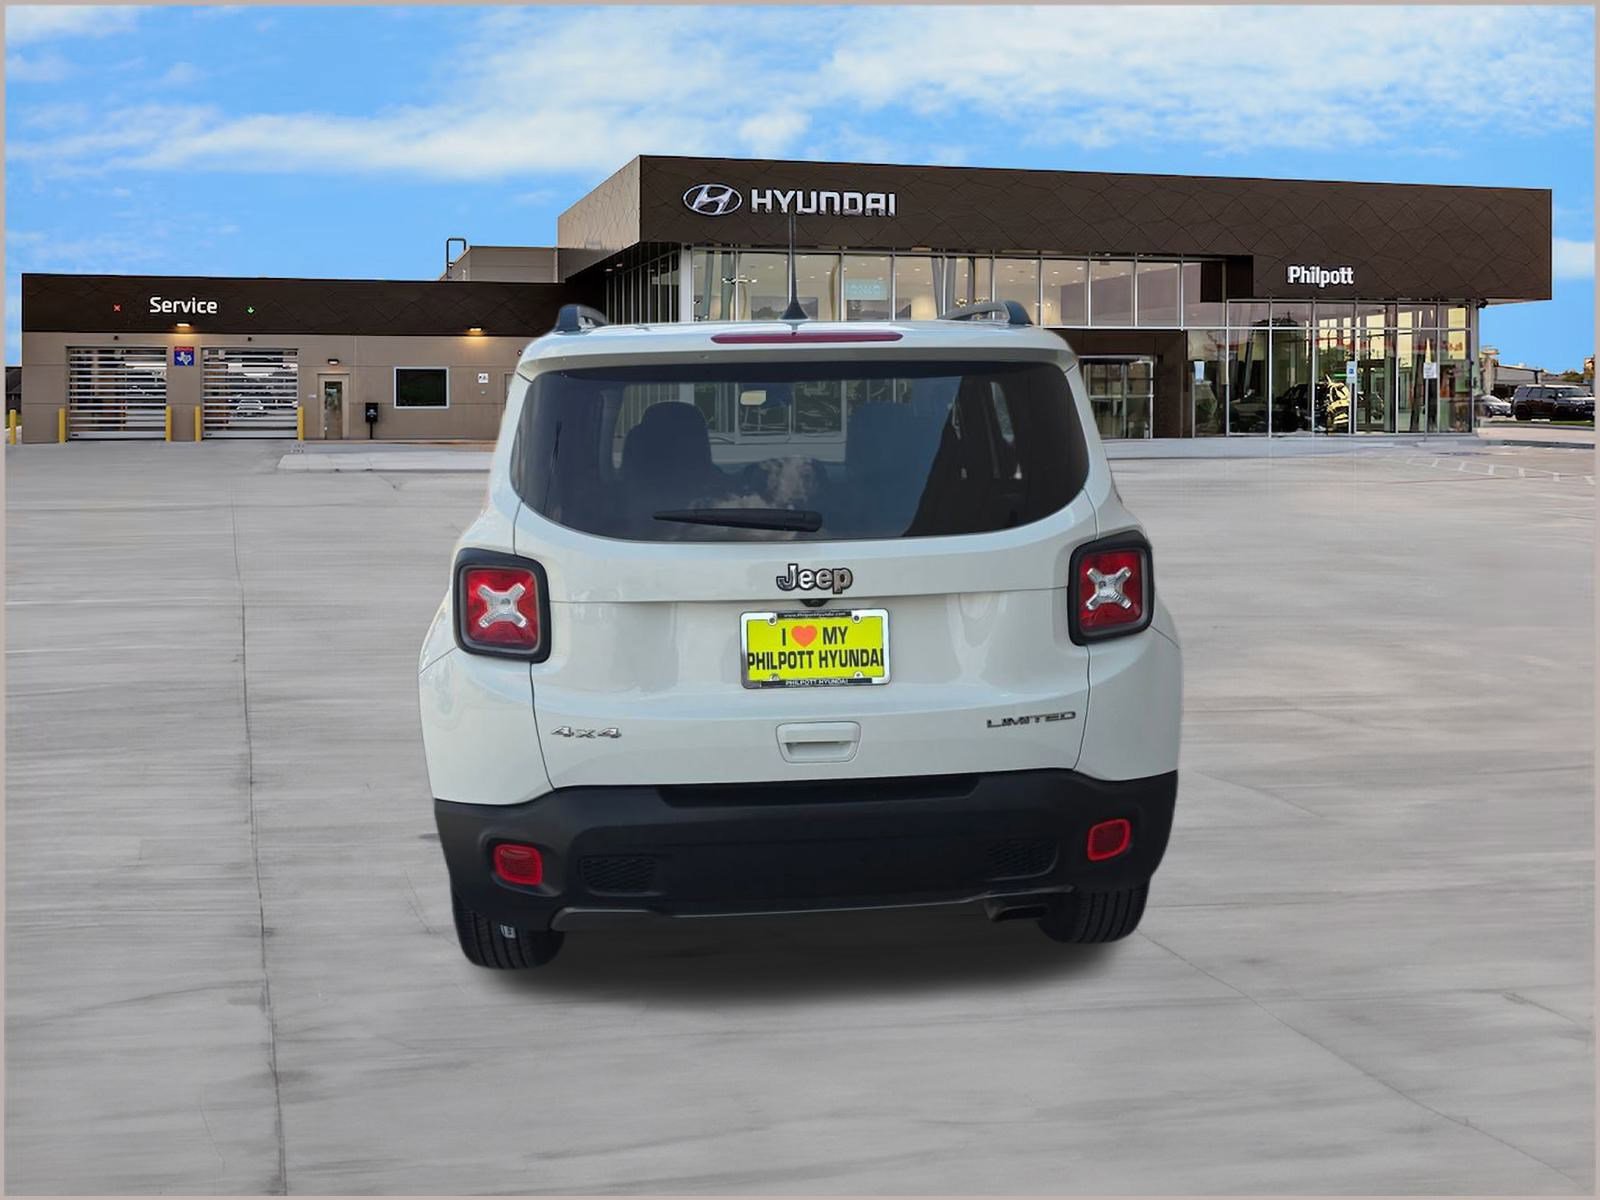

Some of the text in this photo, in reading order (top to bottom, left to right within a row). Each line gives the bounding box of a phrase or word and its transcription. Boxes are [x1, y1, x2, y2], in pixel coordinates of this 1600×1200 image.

[751, 189, 896, 216] HYUNDAI
[1287, 265, 1354, 287] Philpott
[149, 296, 218, 314] Service
[776, 563, 853, 594] Jeep
[781, 626, 849, 646] I MY
[747, 648, 884, 671] PHILPOTT HYUNDAI
[986, 711, 1077, 729] LIMITED
